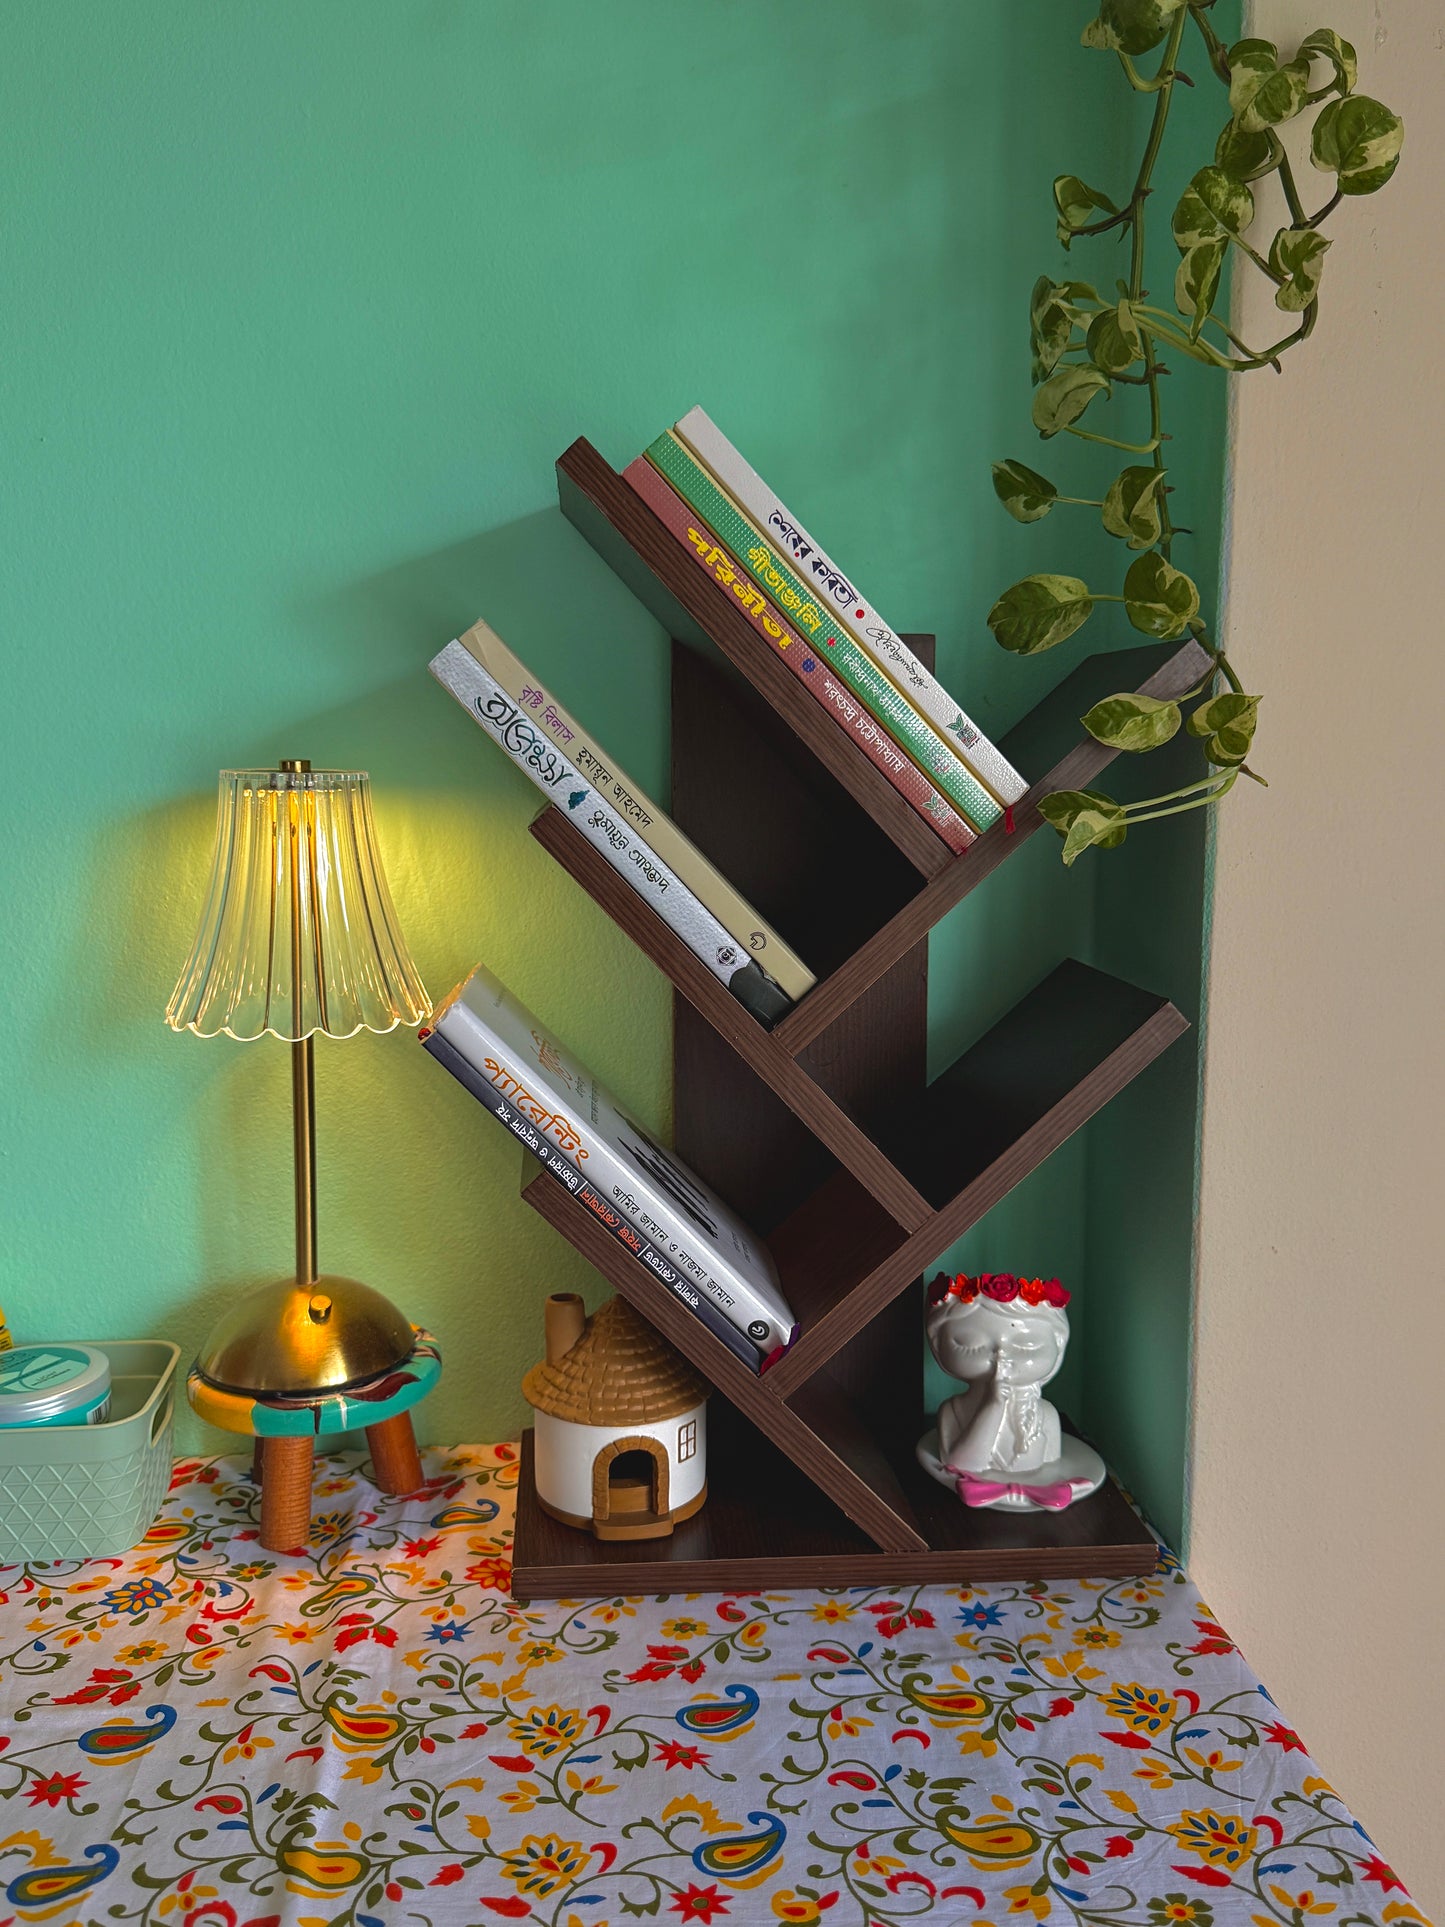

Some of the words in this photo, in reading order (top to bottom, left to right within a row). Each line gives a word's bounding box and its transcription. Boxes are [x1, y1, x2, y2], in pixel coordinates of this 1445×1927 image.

[768, 508, 815, 560] শেষের
[811, 557, 859, 609] কবিতা
[747, 545, 823, 634] গীতাঞ্জলি
[842, 653, 881, 697] রবীন্দ্রনাথ
[878, 689, 907, 723] ঠাকুর
[824, 679, 860, 722] শরৎচন্দ্র
[518, 684, 545, 709] বৃষ্টি
[543, 706, 575, 745] বিলাস
[613, 782, 654, 829] আহমেদ
[474, 692, 574, 787] অপেক্ষা
[628, 849, 670, 894] আহমেদ
[483, 1057, 589, 1171] প্যারেন্টিং
[495, 1101, 512, 1123] সহ
[509, 1117, 540, 1151] অনুবাদ
[547, 1156, 578, 1191] উচ্চারণ
[579, 1187, 620, 1227] কোরআন
[612, 1185, 641, 1215] আমির
[639, 1212, 669, 1243] জামান
[678, 1250, 708, 1281] নাজমা
[706, 1277, 736, 1308] জামান
[617, 1225, 642, 1252] সহজ
[643, 1251, 677, 1282] কোডেড
[673, 1280, 700, 1309] কালার
